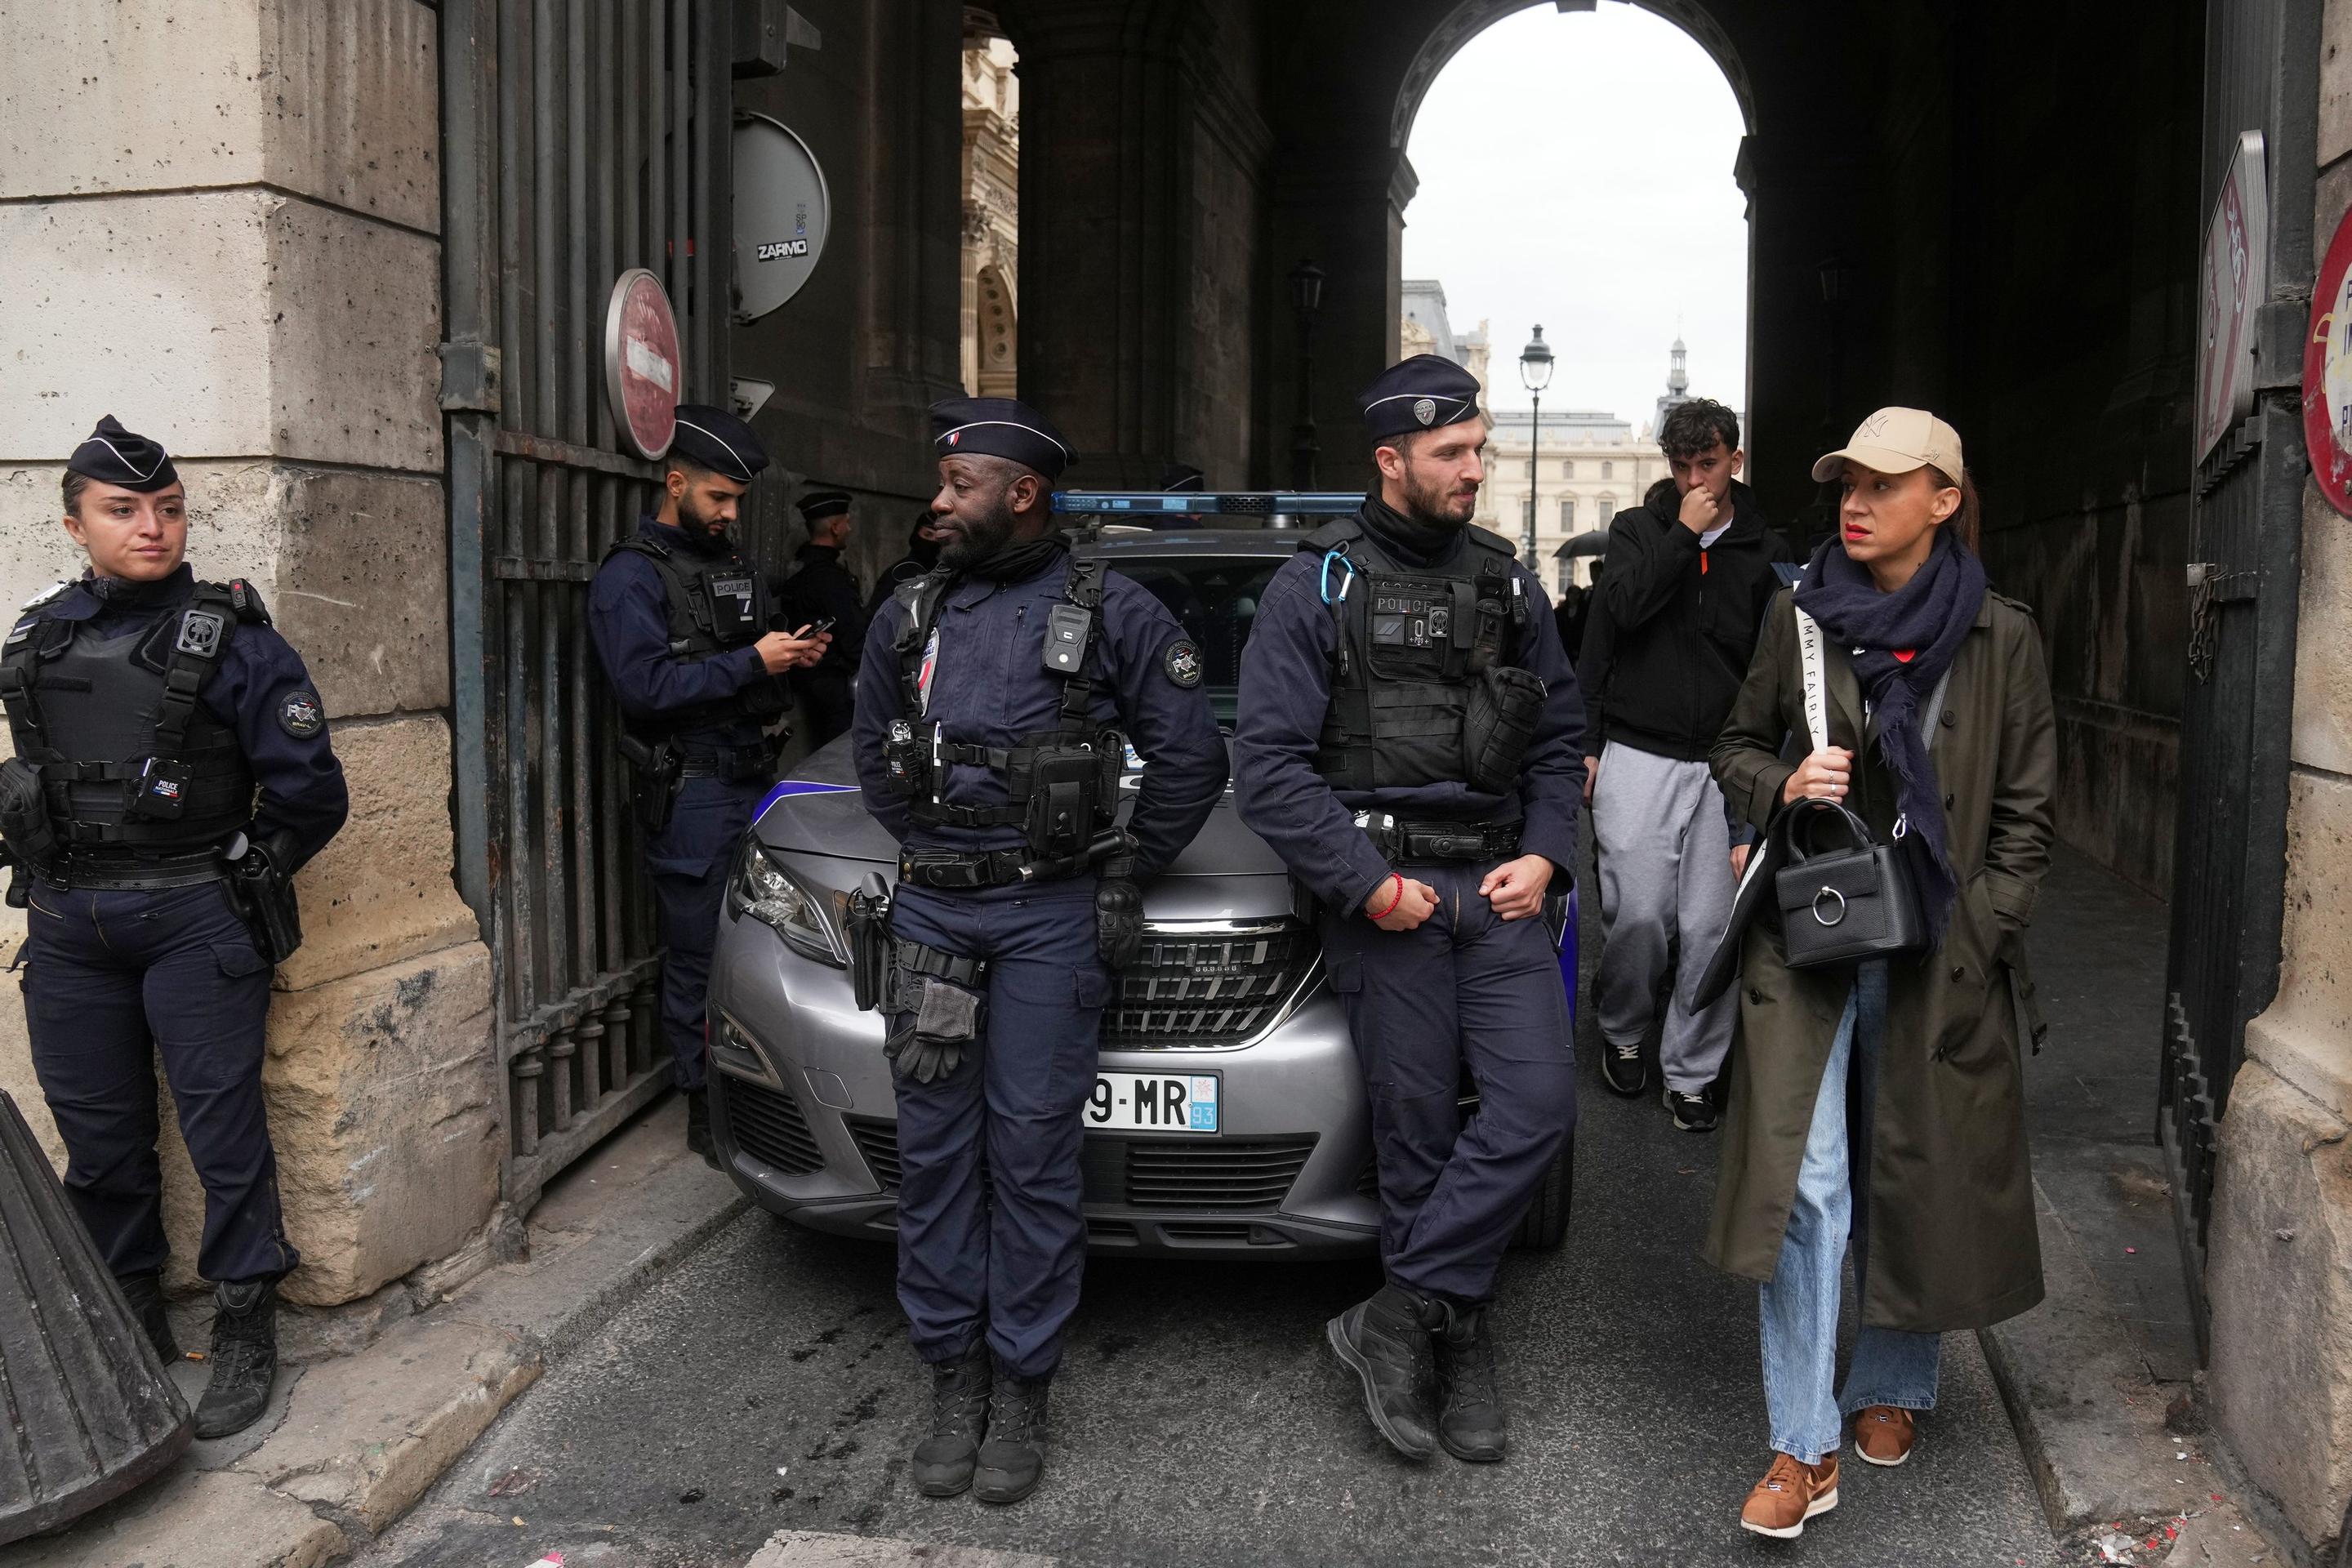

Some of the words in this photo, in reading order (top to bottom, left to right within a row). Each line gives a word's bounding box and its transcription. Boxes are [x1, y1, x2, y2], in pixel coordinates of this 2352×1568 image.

[758, 240, 807, 260] ZARMO
[717, 582, 751, 594] POLICE
[1378, 598, 1432, 612] POLICE
[1803, 617, 1815, 661] IMMY
[1806, 670, 1820, 734] FAIRLY
[158, 780, 179, 791] POLICE
[1192, 1107, 1214, 1125] 93
